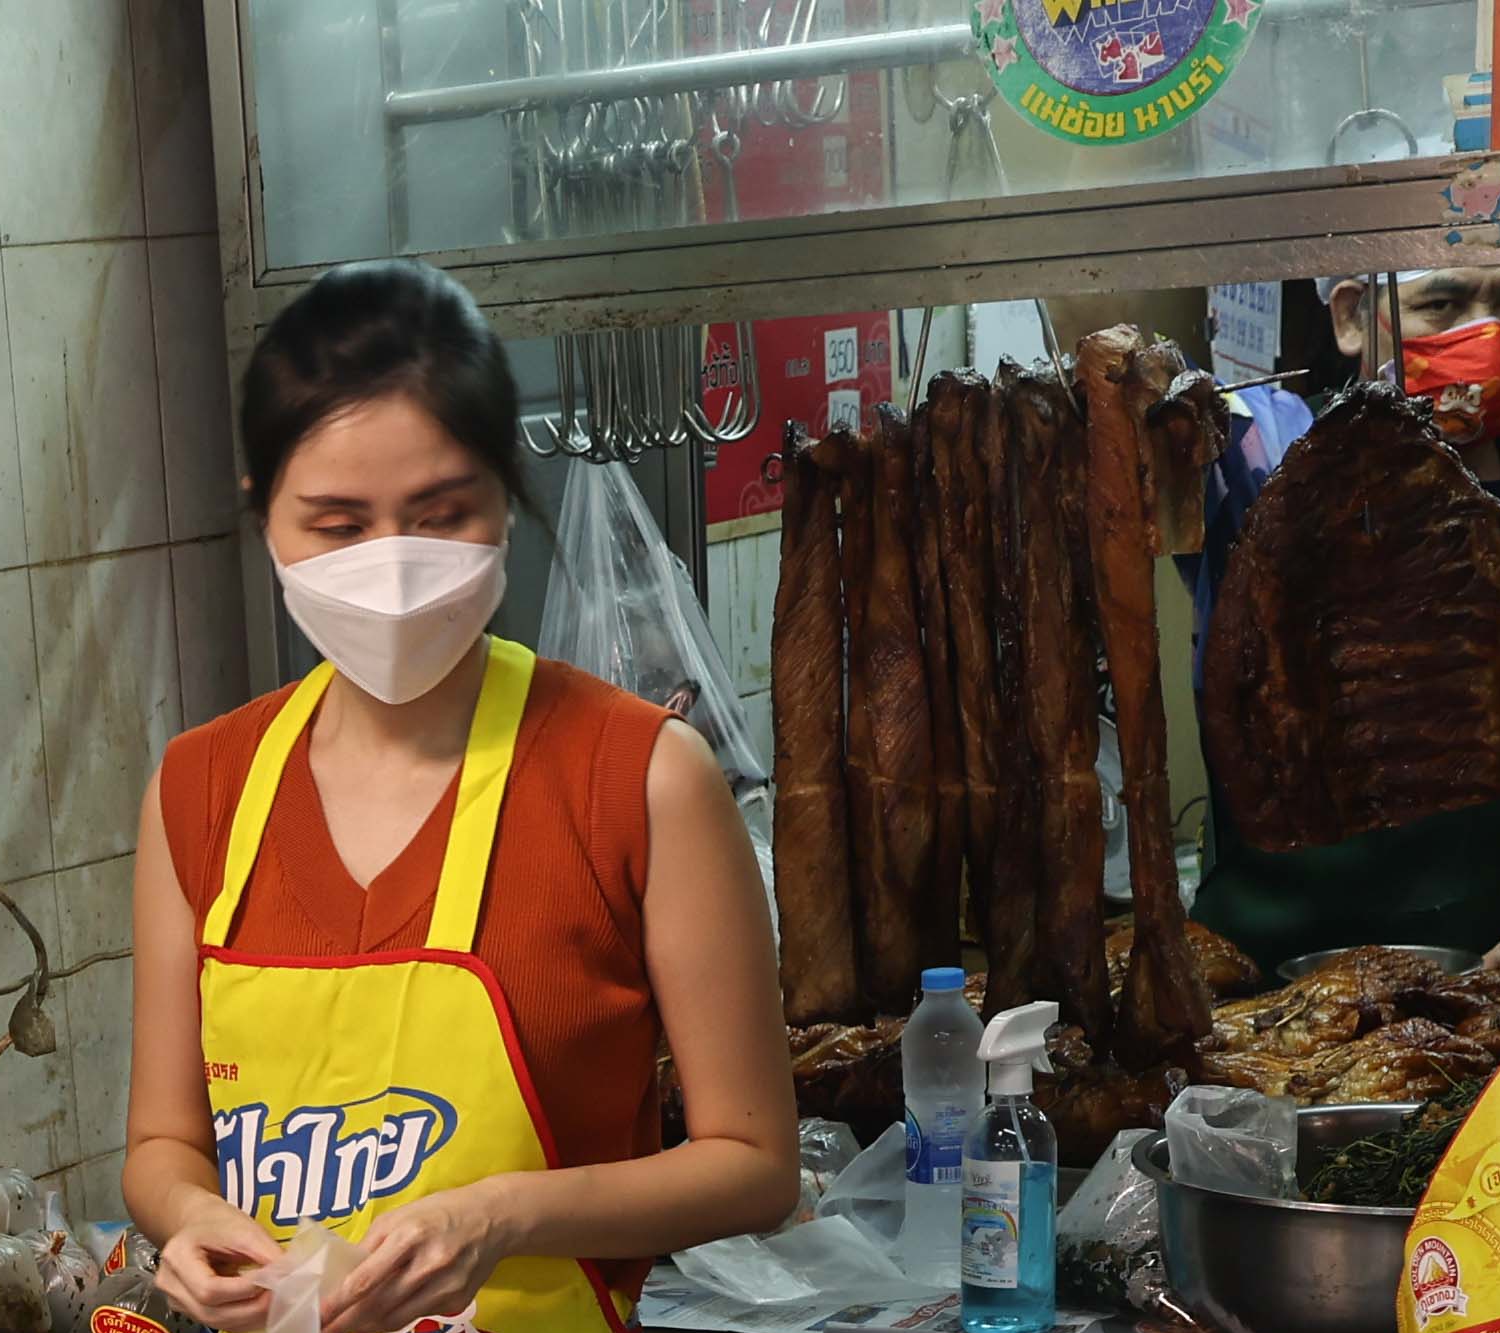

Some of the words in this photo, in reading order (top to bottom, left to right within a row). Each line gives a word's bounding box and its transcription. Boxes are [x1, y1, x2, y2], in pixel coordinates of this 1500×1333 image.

[1020, 84, 1126, 139] แม่ช้อย
[1424, 1239, 1457, 1278] MOUNTAIN
